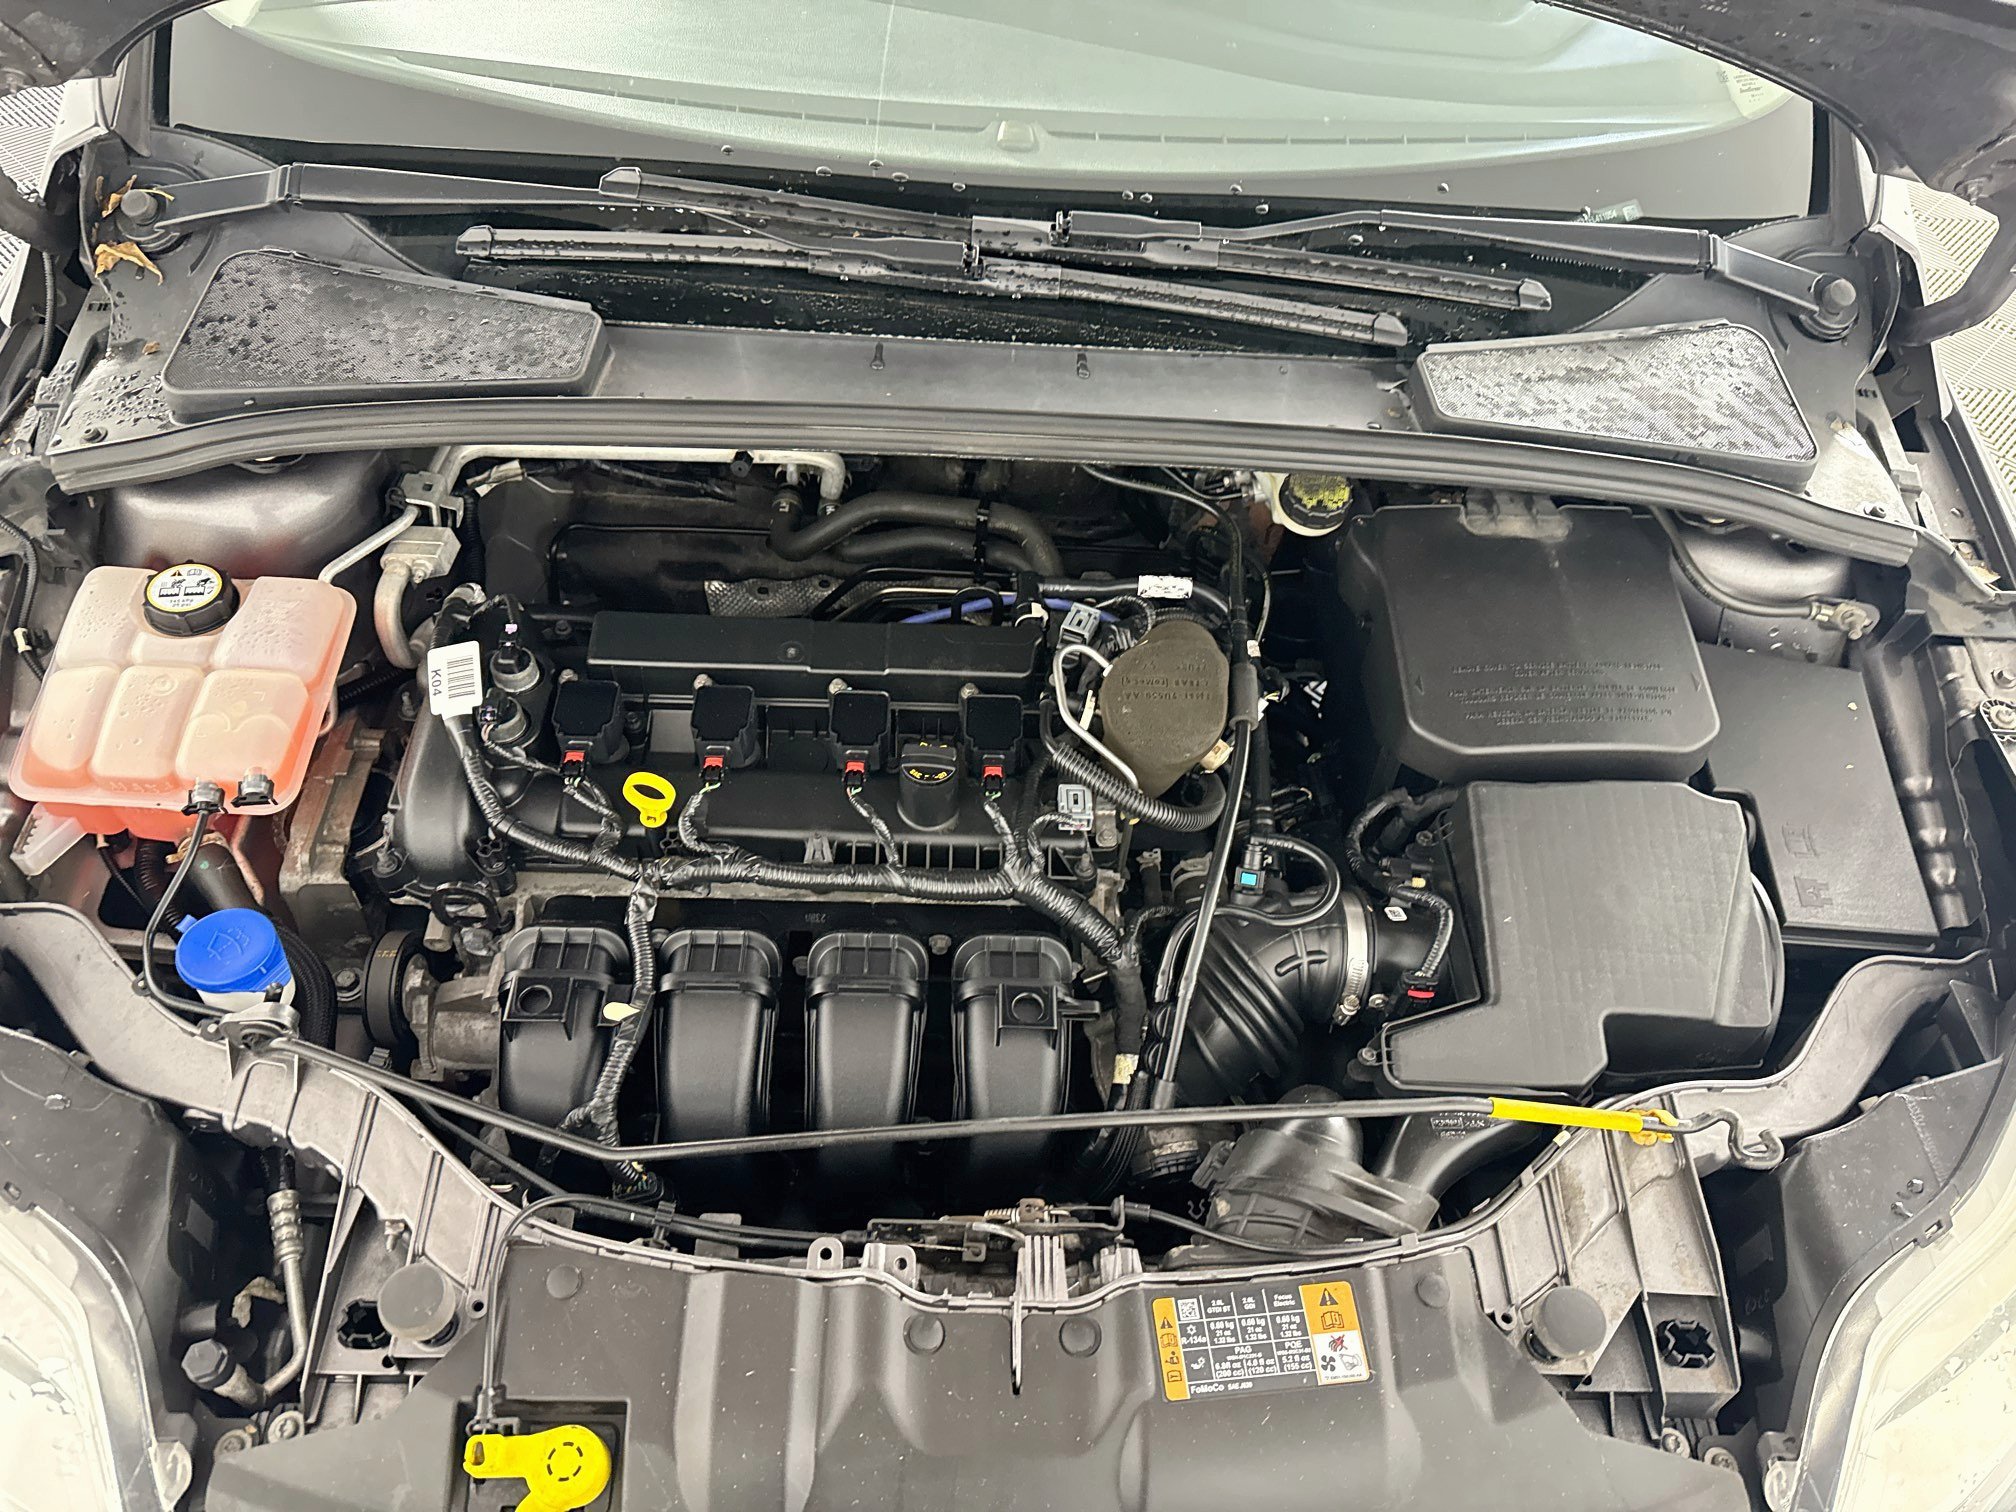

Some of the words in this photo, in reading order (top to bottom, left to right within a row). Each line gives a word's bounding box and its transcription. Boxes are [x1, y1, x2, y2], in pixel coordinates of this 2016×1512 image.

[431, 669, 442, 697] K04
[1256, 1317, 1266, 1327] kg
[1291, 1314, 1300, 1324] kg
[1225, 1321, 1235, 1330] kg
[1181, 1336, 1207, 1345] R-134a
[1234, 1346, 1252, 1354] PAG
[1282, 1356, 1293, 1364] 5.2
[1265, 1365, 1276, 1374] cc)
[1301, 1361, 1312, 1370] cc)
[1232, 1368, 1244, 1377] cc)
[1190, 1383, 1225, 1394] FoMoCo
